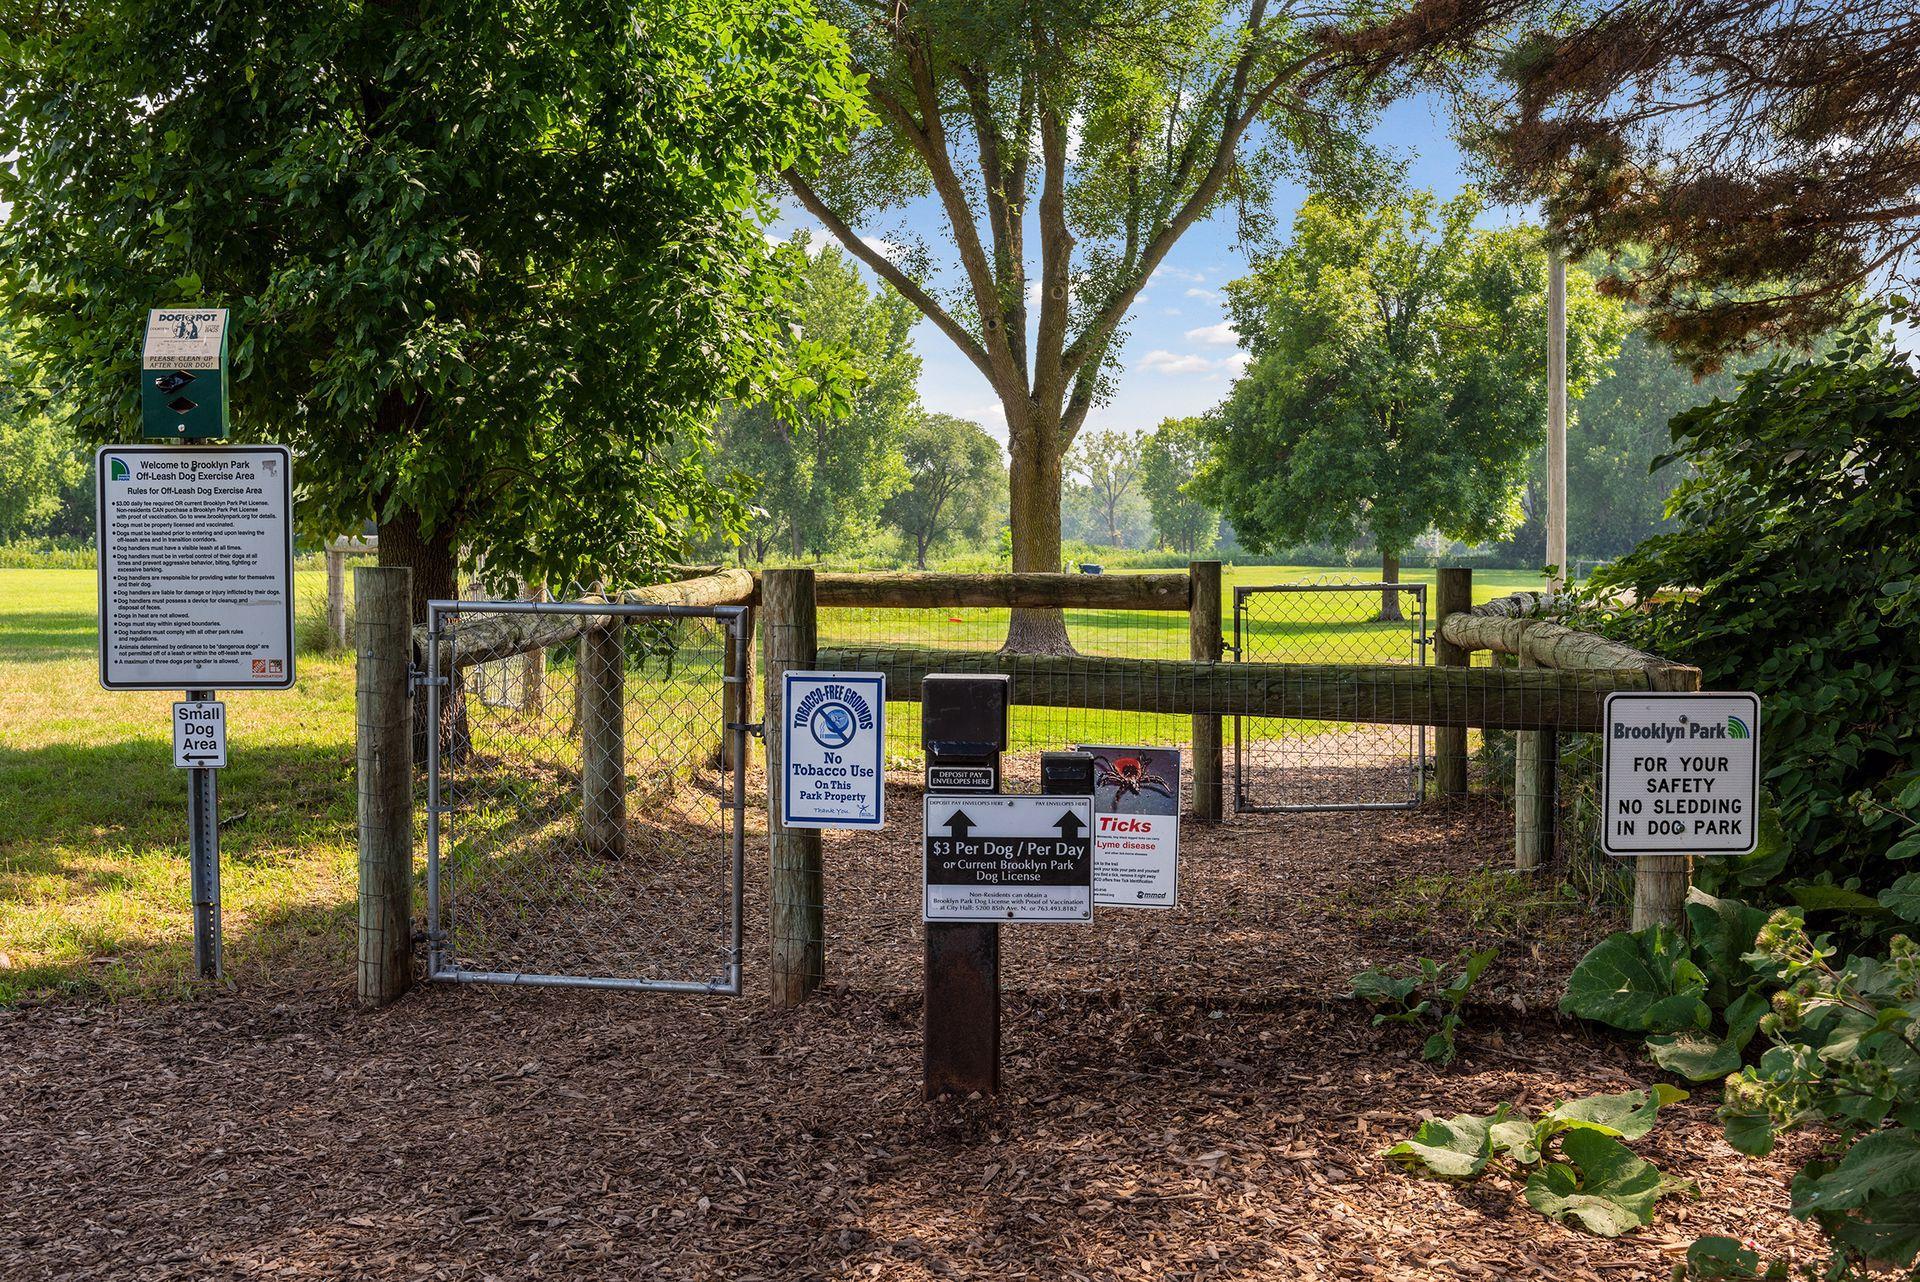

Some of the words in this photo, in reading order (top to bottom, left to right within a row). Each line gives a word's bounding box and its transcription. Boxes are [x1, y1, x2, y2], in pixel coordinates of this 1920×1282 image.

[140, 461, 178, 469] Welcome
[181, 461, 189, 469] to
[191, 461, 228, 471] Brooklyn
[231, 461, 250, 469] Park
[136, 472, 176, 480] Off-Leash
[179, 472, 196, 482] Dog
[198, 472, 233, 480] Exercise
[236, 472, 254, 480] Area
[197, 487, 212, 496] Dog
[794, 685, 844, 728] TOBACCO-FREE
[844, 687, 873, 730] GROUNDS
[179, 708, 219, 720] Small
[185, 723, 214, 738] Dog
[1614, 723, 1685, 743] Brooklyn
[1690, 723, 1726, 739] Park
[183, 738, 217, 750] Area
[824, 752, 842, 764] No
[792, 764, 846, 776] Tobacco
[851, 765, 874, 777] Use
[1634, 757, 1667, 772] FOR
[1680, 757, 1728, 772] YOUR
[815, 780, 828, 789] On
[830, 781, 851, 790] This
[1647, 778, 1714, 793] SAFETY
[800, 791, 822, 800] Park
[825, 792, 865, 803] Property
[1619, 800, 1642, 814] NO
[1654, 799, 1741, 814] SLEDDING
[1100, 817, 1151, 832] Ticks
[1618, 821, 1634, 835] IN
[1694, 820, 1741, 834] PARK
[934, 841, 950, 856] $3
[956, 842, 978, 854] Per
[984, 842, 1013, 859] Dog
[1018, 842, 1023, 856] /
[1028, 843, 1050, 855] Per
[1056, 843, 1084, 859] Day
[1097, 840, 1120, 850] Lyme
[1123, 841, 1156, 850] disease
[958, 860, 996, 869] Current
[1000, 860, 1046, 872] Brooklyn
[1051, 860, 1073, 869] Park
[977, 871, 998, 883] Dog
[1002, 871, 1040, 881] License
